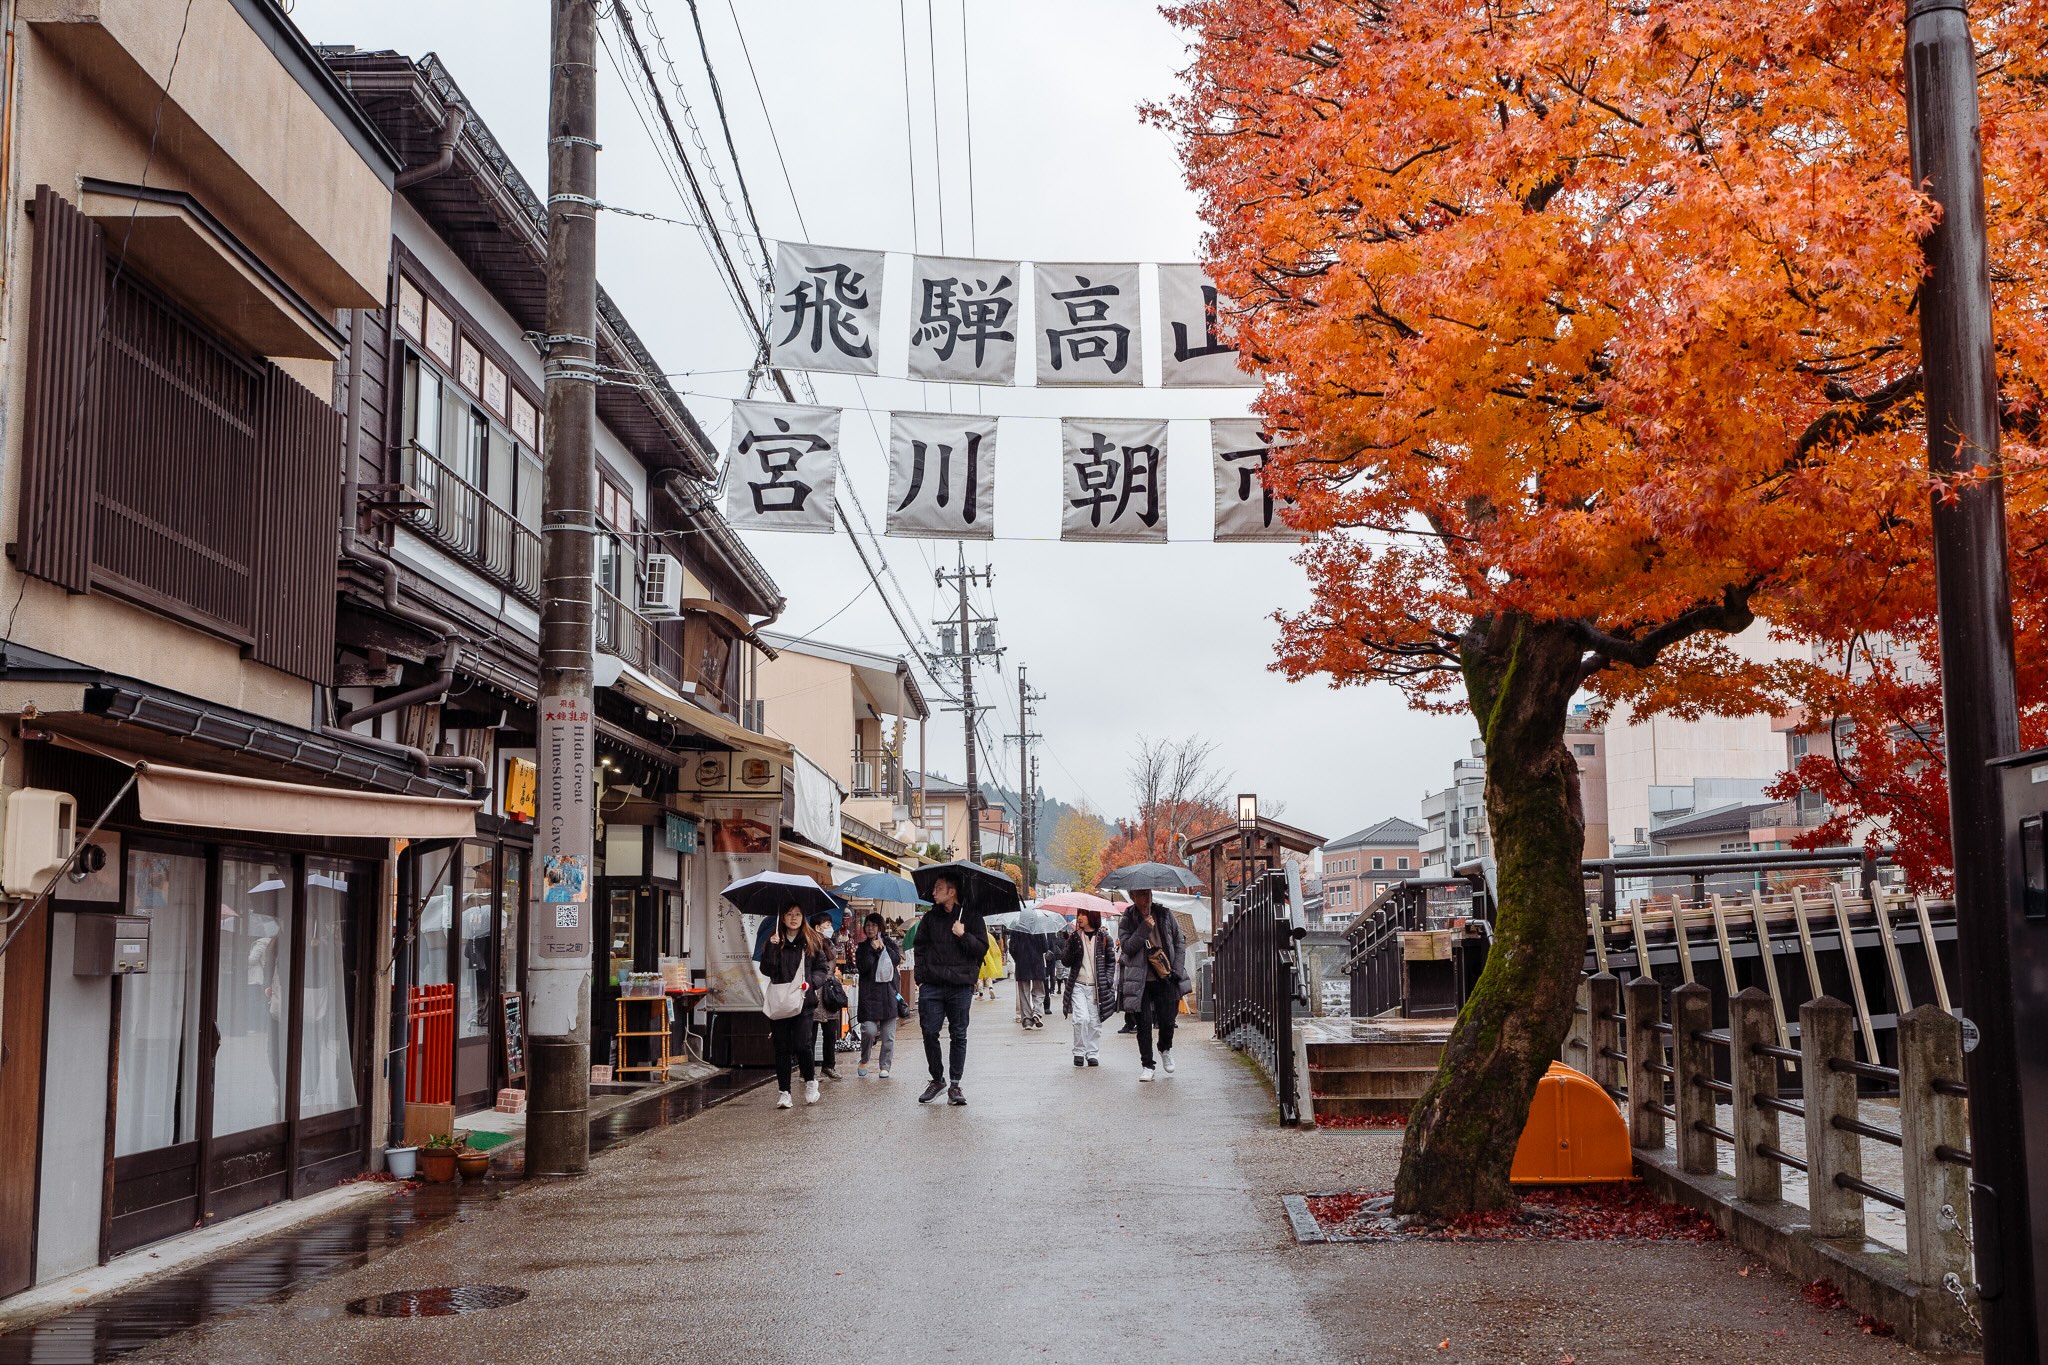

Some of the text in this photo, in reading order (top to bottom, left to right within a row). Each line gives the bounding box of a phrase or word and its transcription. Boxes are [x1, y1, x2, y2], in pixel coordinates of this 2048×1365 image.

[737, 418, 1295, 528] 宮川朝市
[551, 726, 565, 854] Limestone Cave
[574, 725, 585, 805] Hida Great
[546, 943, 583, 953] 下三之町
